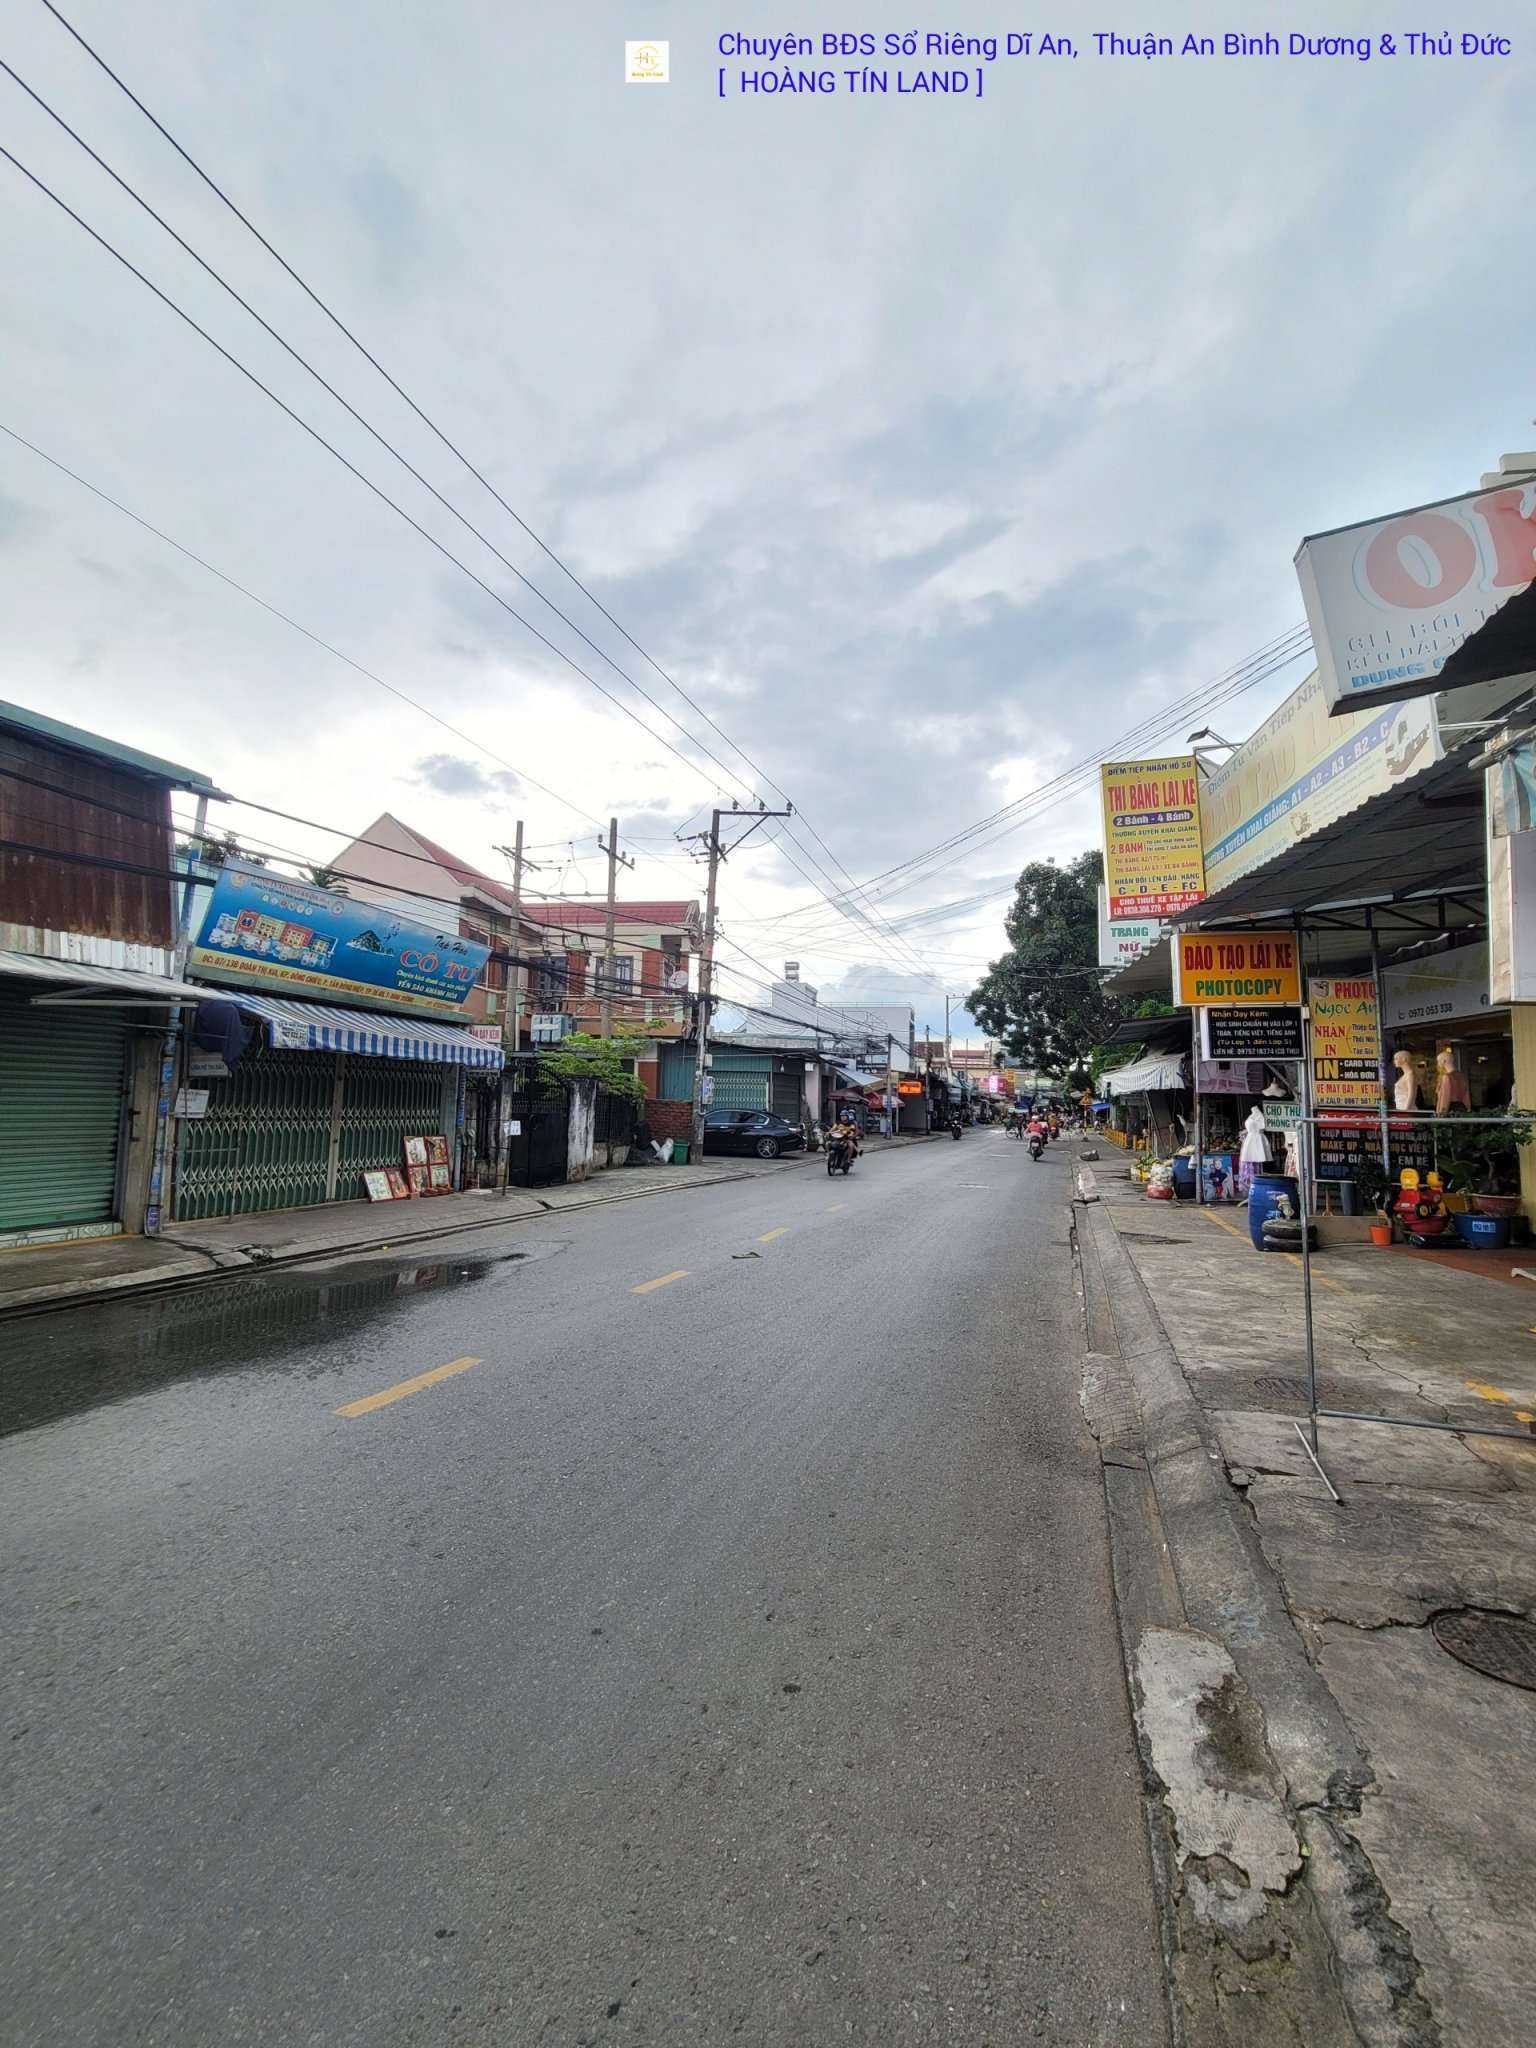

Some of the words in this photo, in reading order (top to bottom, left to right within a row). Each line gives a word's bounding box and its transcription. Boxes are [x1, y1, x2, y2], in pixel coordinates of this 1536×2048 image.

[1129, 764, 1144, 774] TIẾP
[1146, 762, 1168, 773] NHẬN
[1291, 787, 1301, 807] A1
[1310, 772, 1323, 792] A2
[1331, 755, 1344, 777] A3
[1354, 736, 1369, 759] B2
[1108, 784, 1127, 812] THI
[1129, 777, 1160, 811] BẰNG
[1162, 776, 1180, 808] LÁI
[1182, 778, 1197, 806] XE
[1116, 816, 1123, 826] 2
[1125, 814, 1149, 825] Bánh
[1157, 813, 1164, 822] 4
[1166, 811, 1191, 821] Bánh
[1111, 844, 1117, 855] 2
[1118, 886, 1126, 895] C
[1161, 883, 1168, 892] E
[1182, 881, 1197, 890] FC
[1120, 897, 1135, 906] CHO
[1137, 894, 1156, 905] THUÊ
[1157, 895, 1167, 903] XE
[1169, 893, 1184, 902] TẬP
[1185, 892, 1198, 901] LÁI
[1111, 927, 1149, 938] TRANG
[1119, 941, 1141, 952] NỮ
[1185, 942, 1213, 971] ĐÀO
[1217, 944, 1245, 975] TẠO
[1249, 940, 1271, 970] LÁI
[1275, 943, 1293, 969] XE
[400, 950, 438, 973] CÔ
[443, 961, 480, 983] TƯ
[1196, 978, 1282, 997] PHOTOCOPY
[1211, 1010, 1232, 1018] Nhận
[1315, 1002, 1351, 1019] Ngọc
[1408, 1007, 1425, 1018] 0972
[1315, 1022, 1346, 1039] NHẬN
[1325, 1044, 1337, 1056] IN
[1316, 1060, 1339, 1079] IN
[1344, 1070, 1359, 1079] HÓA
[1360, 1071, 1376, 1079] ĐƠN
[1265, 1105, 1282, 1116] CHO
[1284, 1105, 1301, 1117] THU
[1320, 1141, 1345, 1151] MAKE
[1346, 1141, 1358, 1151] UP
[1320, 1152, 1345, 1164] CHỤP
[1398, 1156, 1414, 1166] EM
